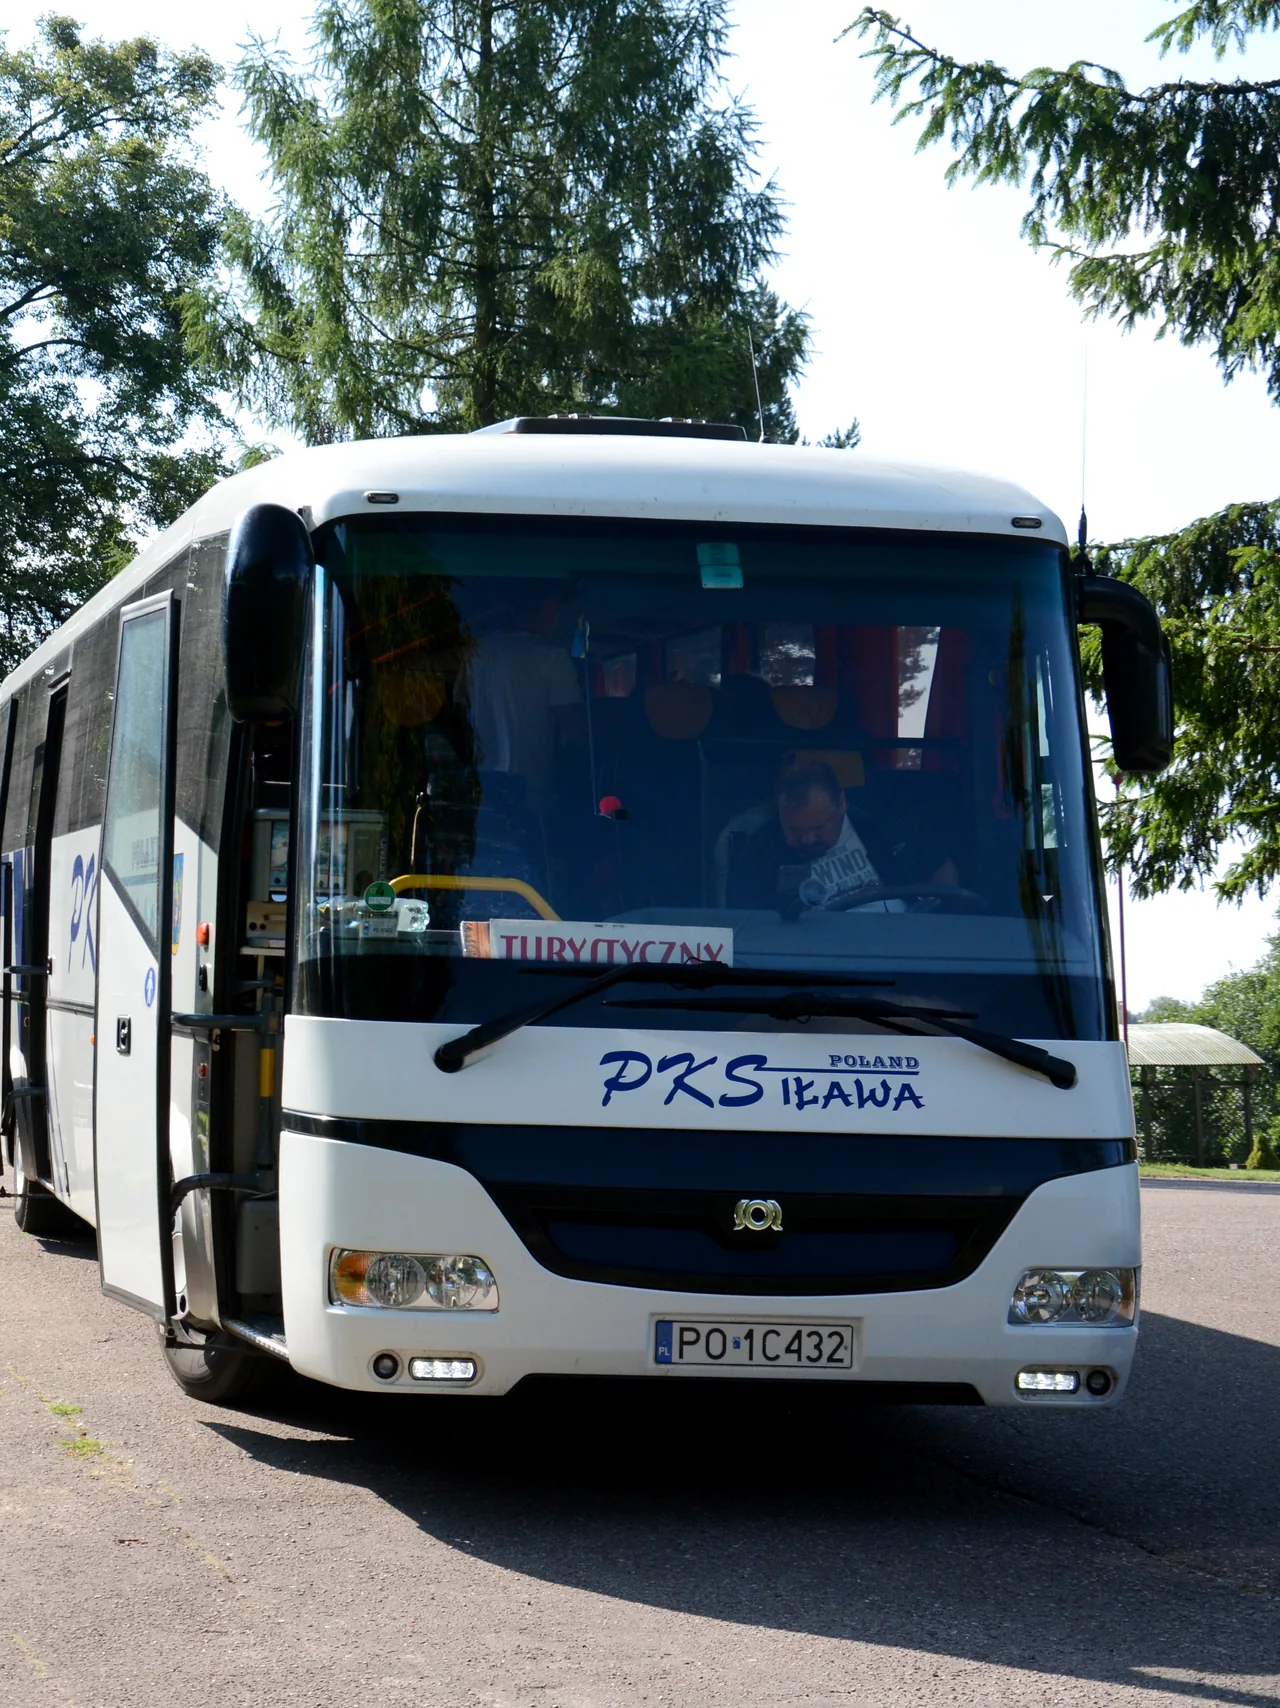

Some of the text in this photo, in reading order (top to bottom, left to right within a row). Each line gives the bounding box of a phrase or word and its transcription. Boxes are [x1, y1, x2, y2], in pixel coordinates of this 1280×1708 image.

[811, 847, 867, 886] WIND
[599, 1050, 926, 1112] PKS IŁAWA
[828, 1054, 920, 1070] POLAND
[658, 1326, 845, 1364] PL PO 1C432
